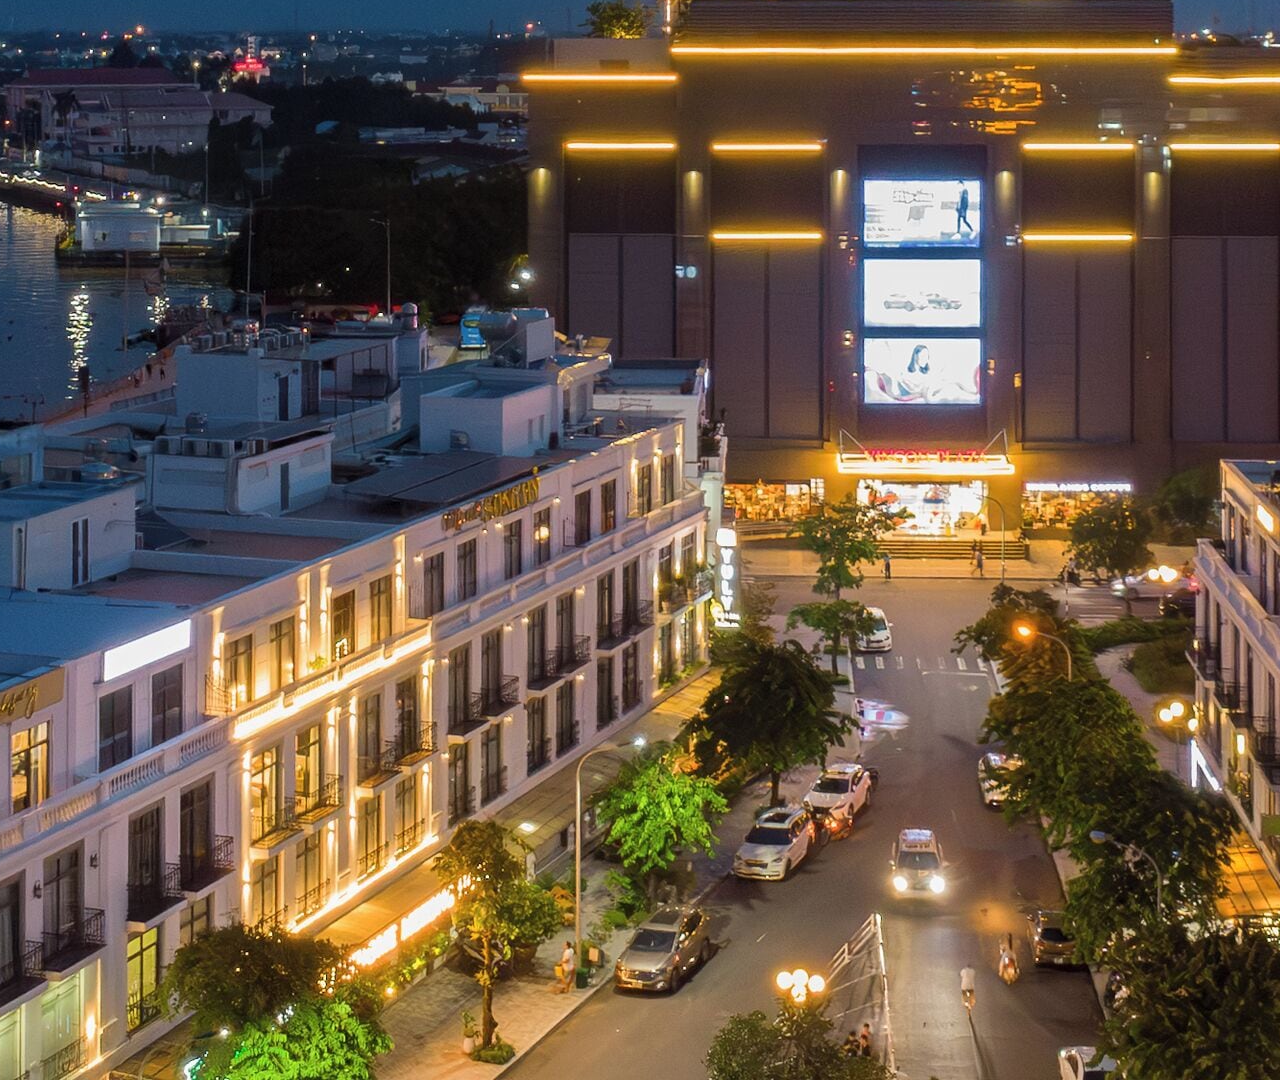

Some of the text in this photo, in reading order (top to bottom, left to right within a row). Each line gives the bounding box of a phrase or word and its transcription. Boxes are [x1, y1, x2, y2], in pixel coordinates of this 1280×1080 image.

[864, 448, 989, 463] VINCOM PLAZA
[720, 547, 734, 611] YULY
